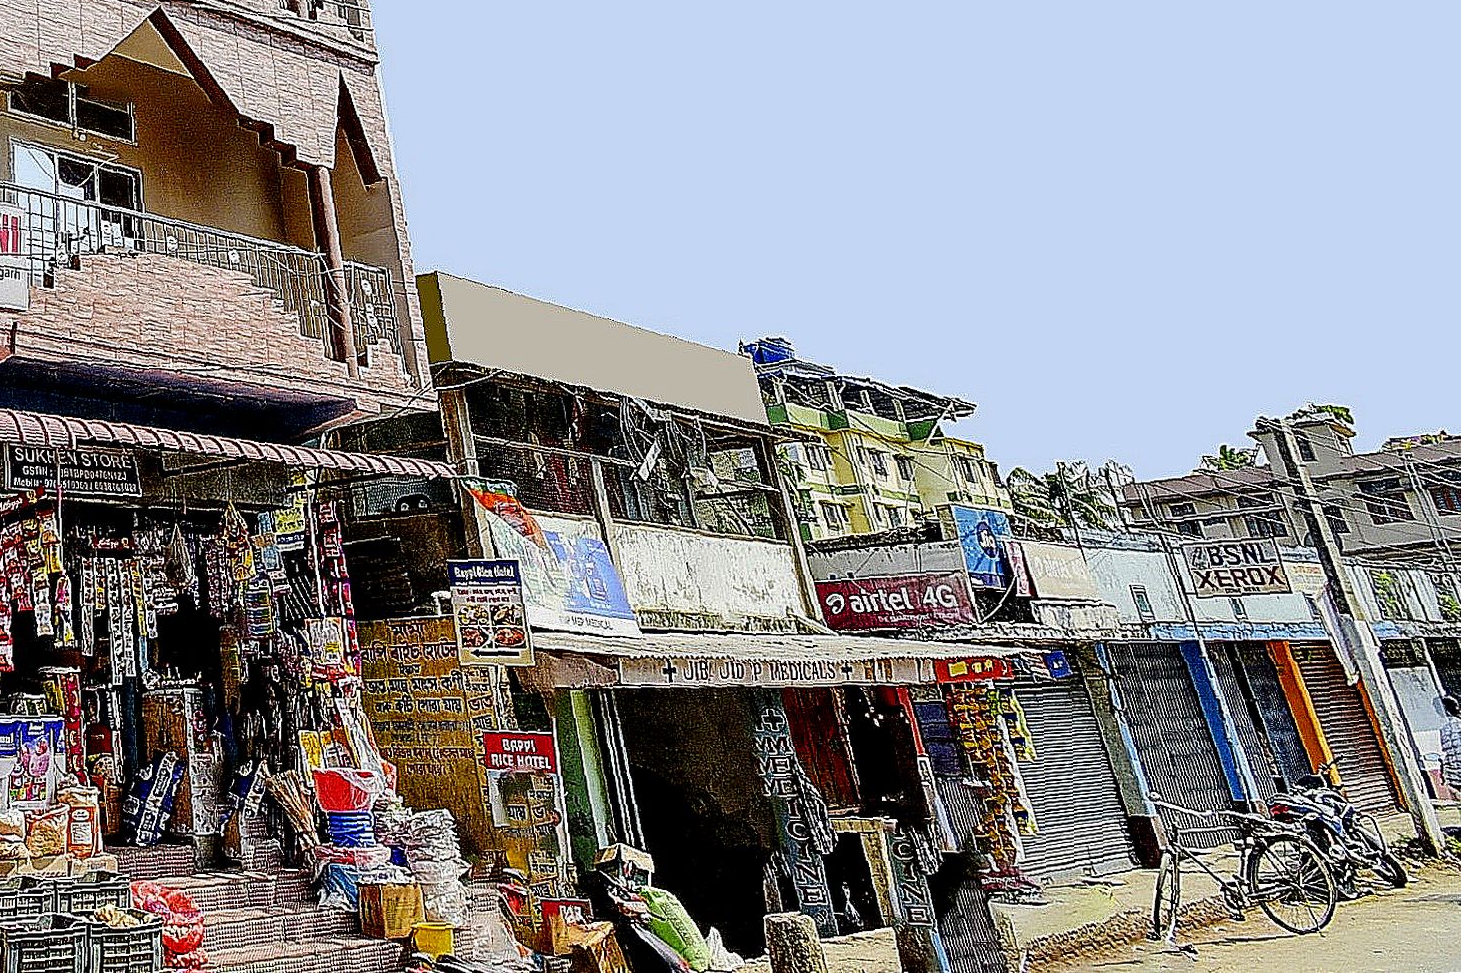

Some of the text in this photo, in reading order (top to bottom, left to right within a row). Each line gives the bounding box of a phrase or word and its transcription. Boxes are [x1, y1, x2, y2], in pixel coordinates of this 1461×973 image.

[14, 447, 132, 469] SUKHEN STORE
[22, 465, 48, 476] GSTIN
[1206, 543, 1277, 567] BSNL
[1193, 566, 1286, 589] XEROX
[848, 584, 959, 613] airtel 4G
[770, 660, 837, 681] MEDICALS
[490, 753, 515, 767] RICE
[516, 755, 552, 770] HOTEL
